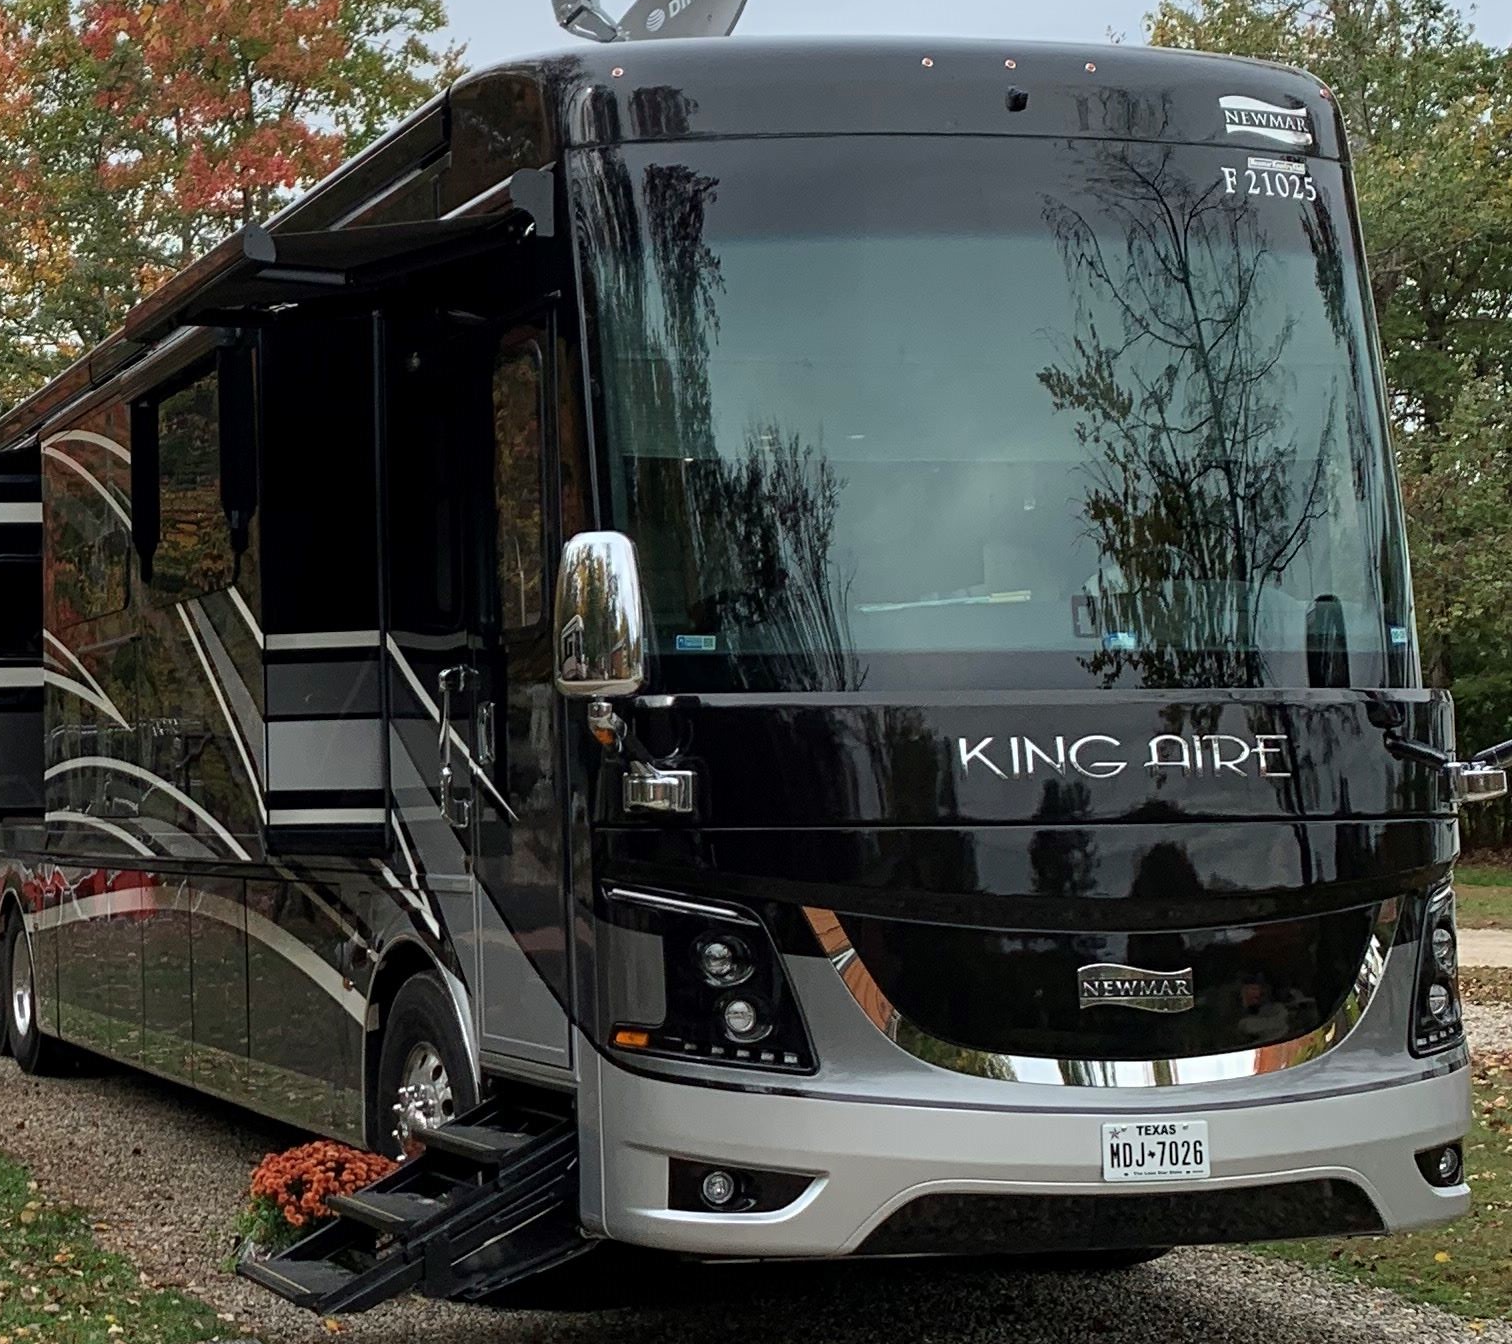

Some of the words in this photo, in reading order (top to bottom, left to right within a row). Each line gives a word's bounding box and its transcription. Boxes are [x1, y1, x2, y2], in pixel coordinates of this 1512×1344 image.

[1224, 109, 1309, 132] NEWMAR
[1220, 166, 1237, 194] F
[1244, 169, 1317, 201] 21025
[959, 735, 1128, 779] KING
[1144, 734, 1292, 778] AIRE
[1082, 979, 1192, 997] NEWMAR
[1136, 1124, 1177, 1136] TEXAS
